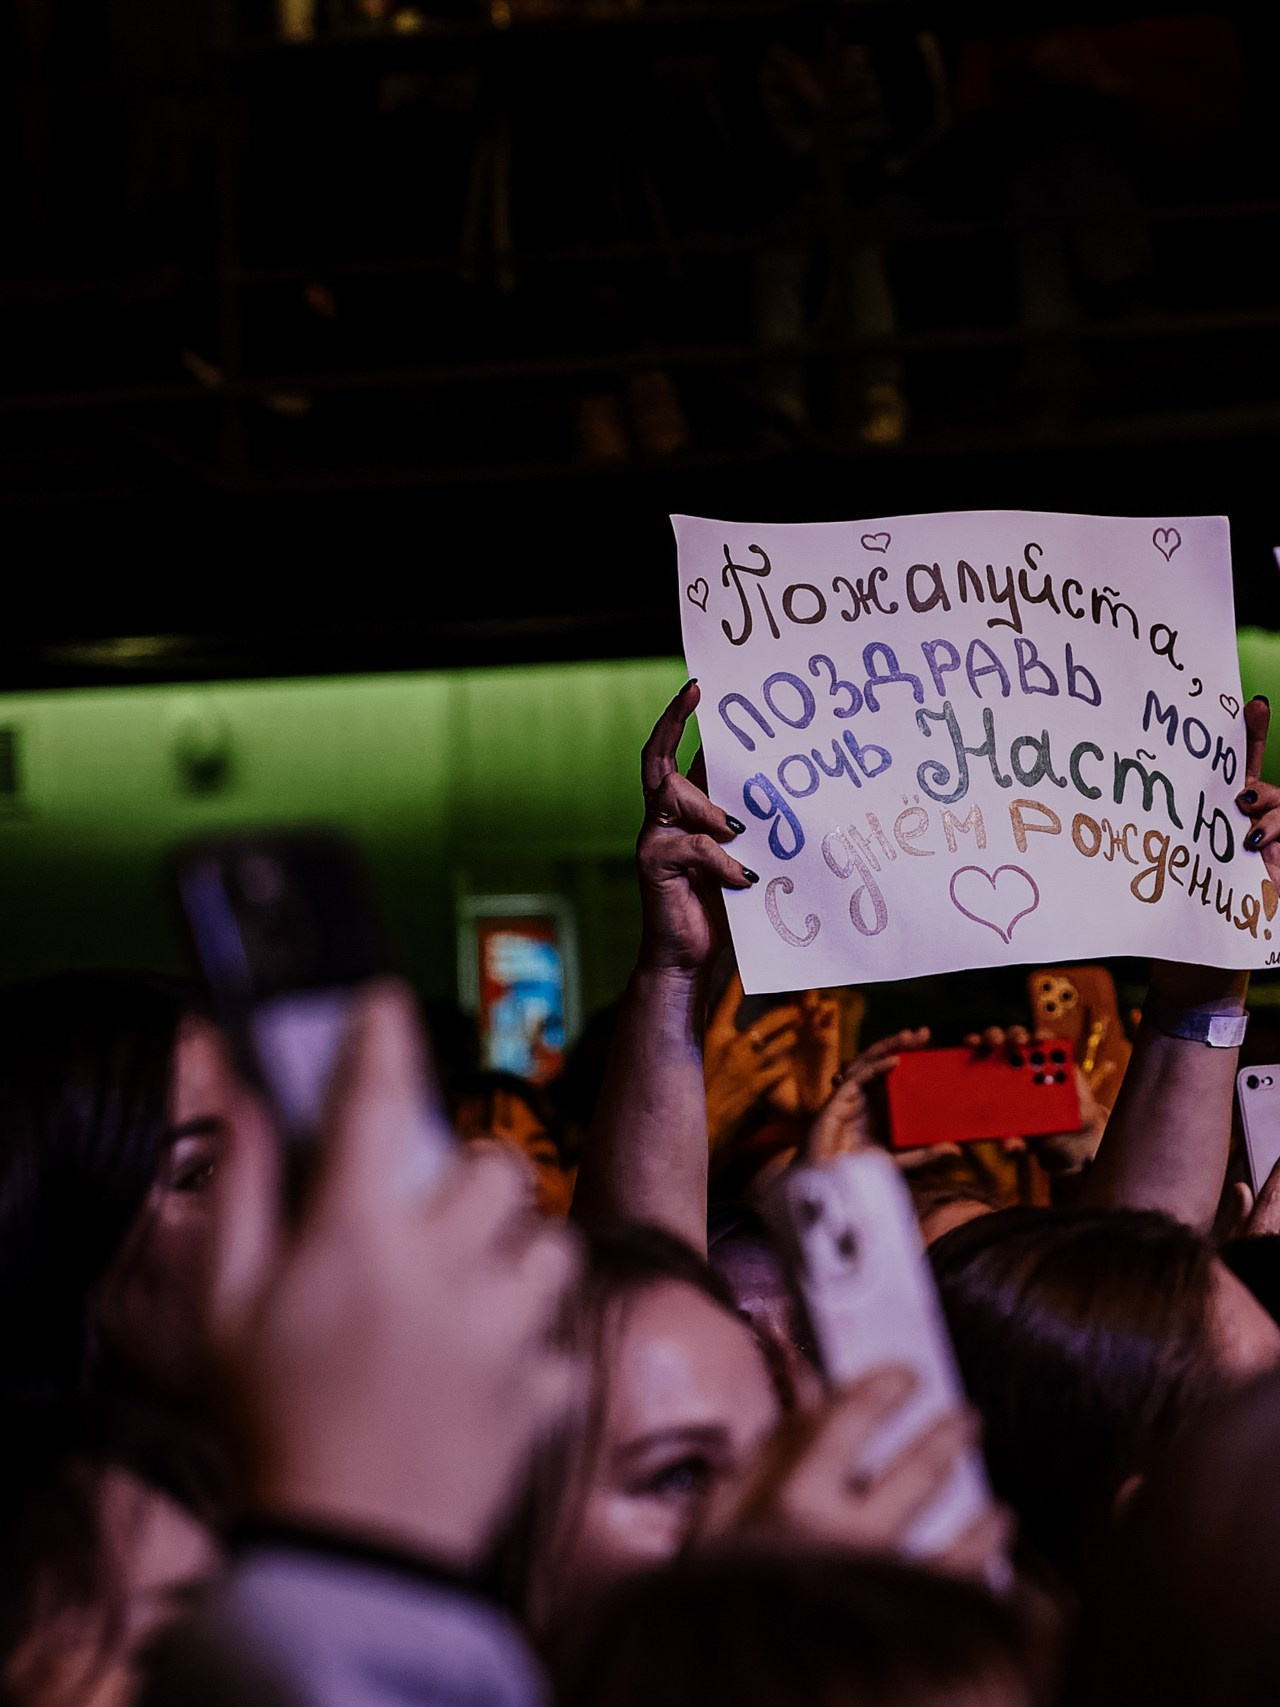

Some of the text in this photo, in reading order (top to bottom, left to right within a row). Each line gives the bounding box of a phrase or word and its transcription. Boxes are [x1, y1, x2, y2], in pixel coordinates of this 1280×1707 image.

[721, 542, 1203, 697] Пожалуйста,
[743, 700, 1235, 864] дочь Настю
